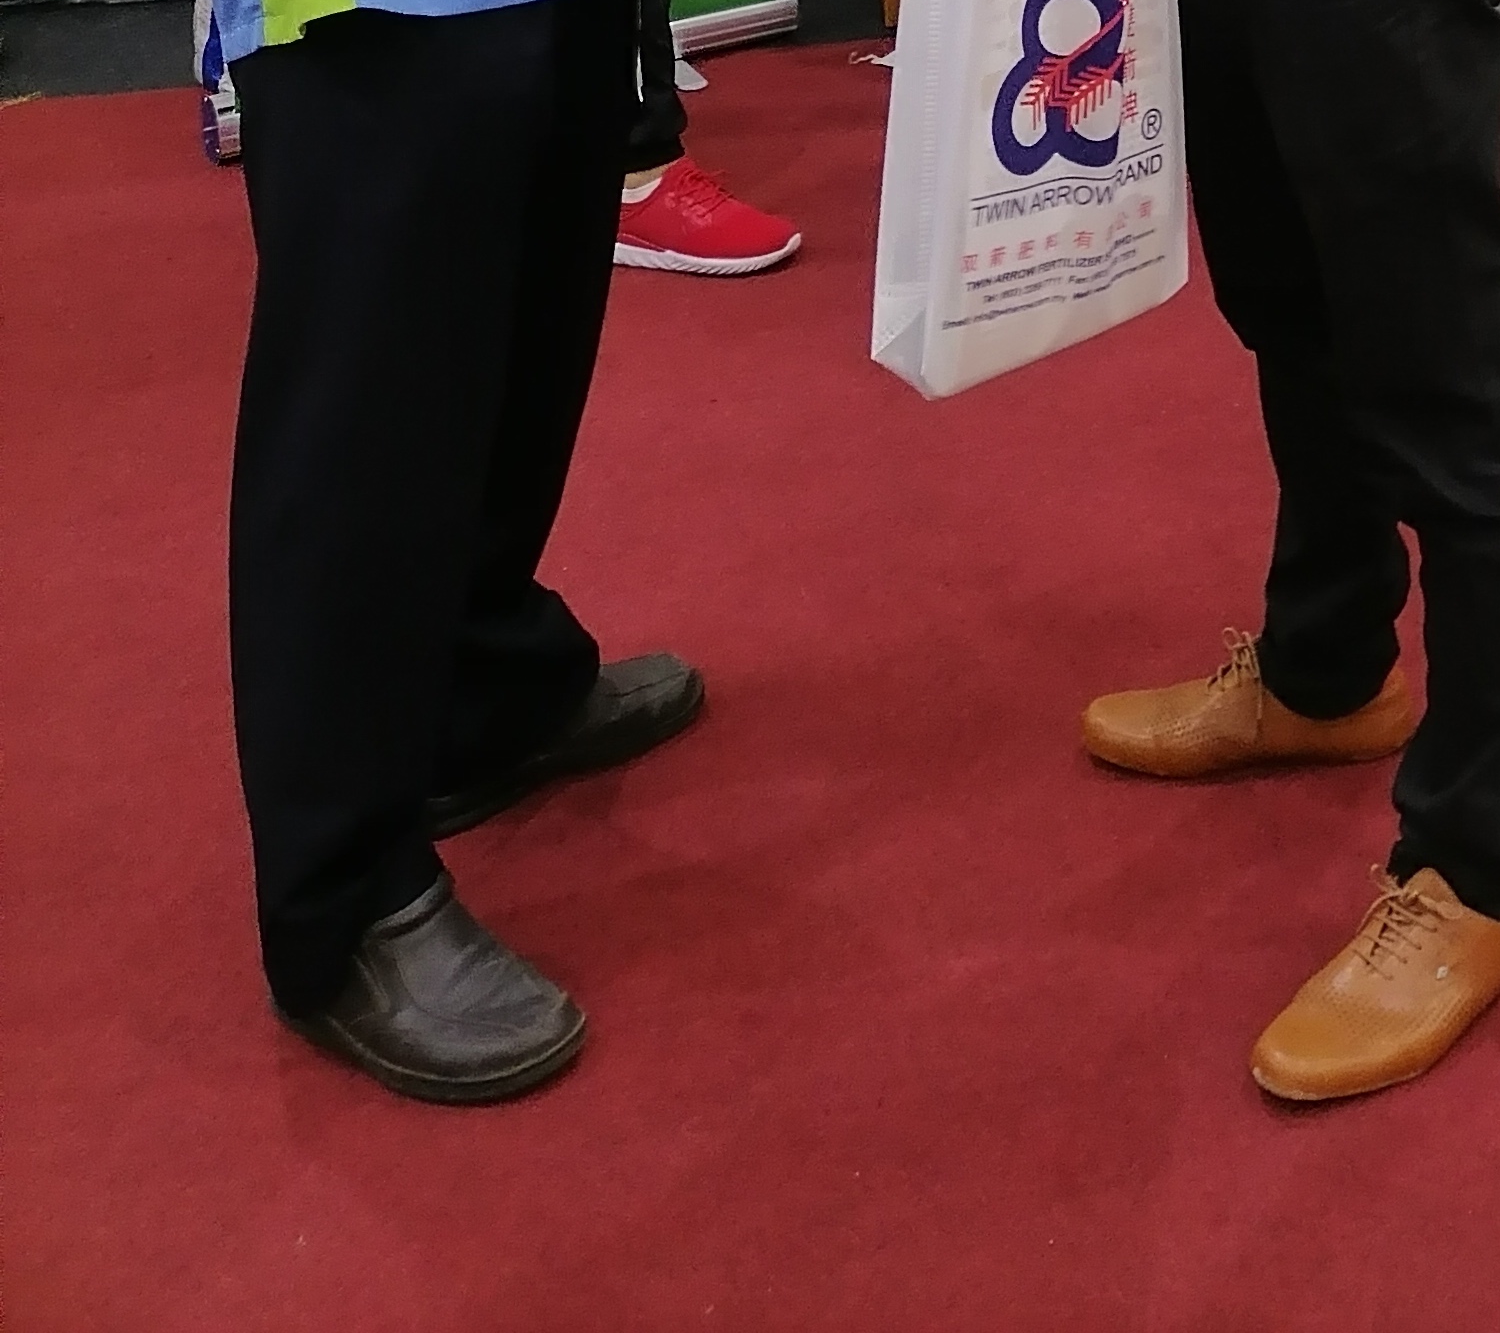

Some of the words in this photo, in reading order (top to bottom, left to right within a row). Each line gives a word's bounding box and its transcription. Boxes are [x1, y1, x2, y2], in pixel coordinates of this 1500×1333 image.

[972, 199, 1026, 227] TWIN
[1029, 184, 1114, 215] ARROW
[1114, 153, 1164, 187] RAND
[994, 266, 1035, 284] ARROW
